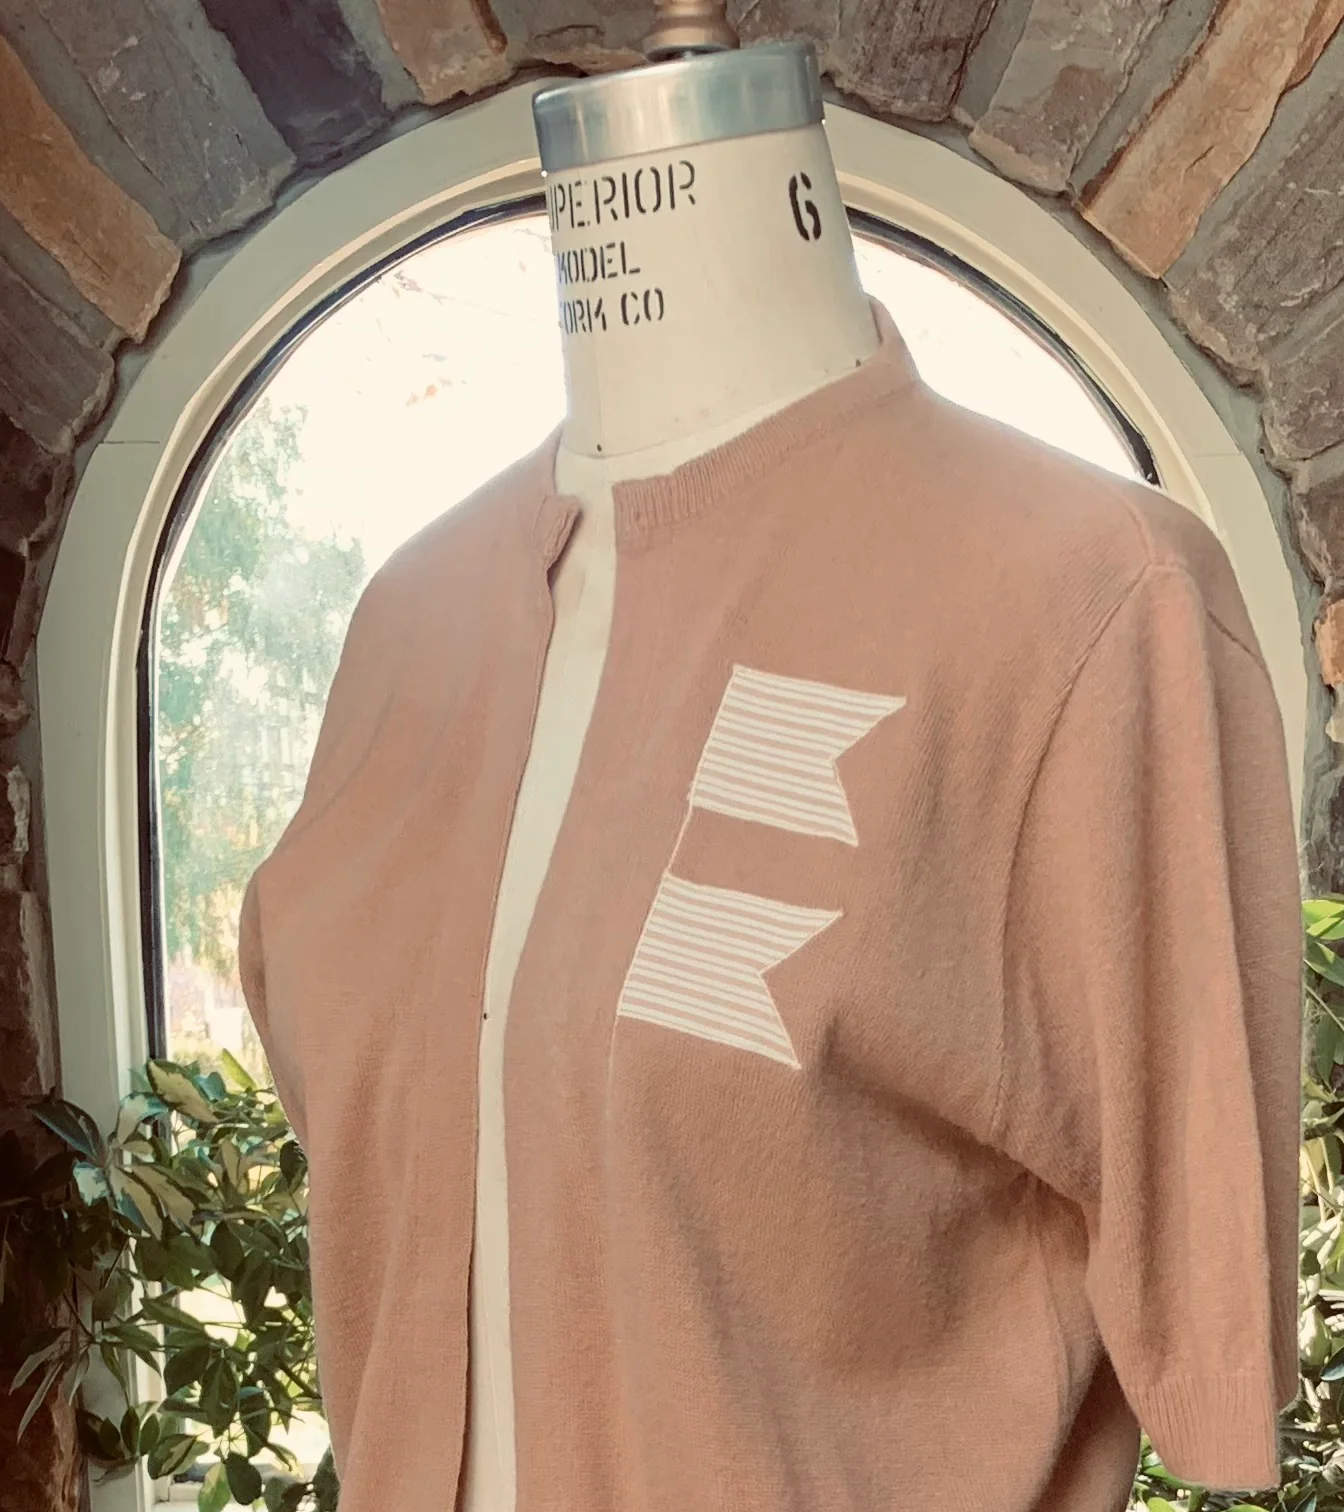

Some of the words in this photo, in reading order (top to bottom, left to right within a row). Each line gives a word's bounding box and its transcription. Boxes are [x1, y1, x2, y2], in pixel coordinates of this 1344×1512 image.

[788, 171, 822, 242] 6
[557, 240, 642, 285] MODEL
[560, 296, 608, 335] ORM
[619, 286, 665, 327] CO
